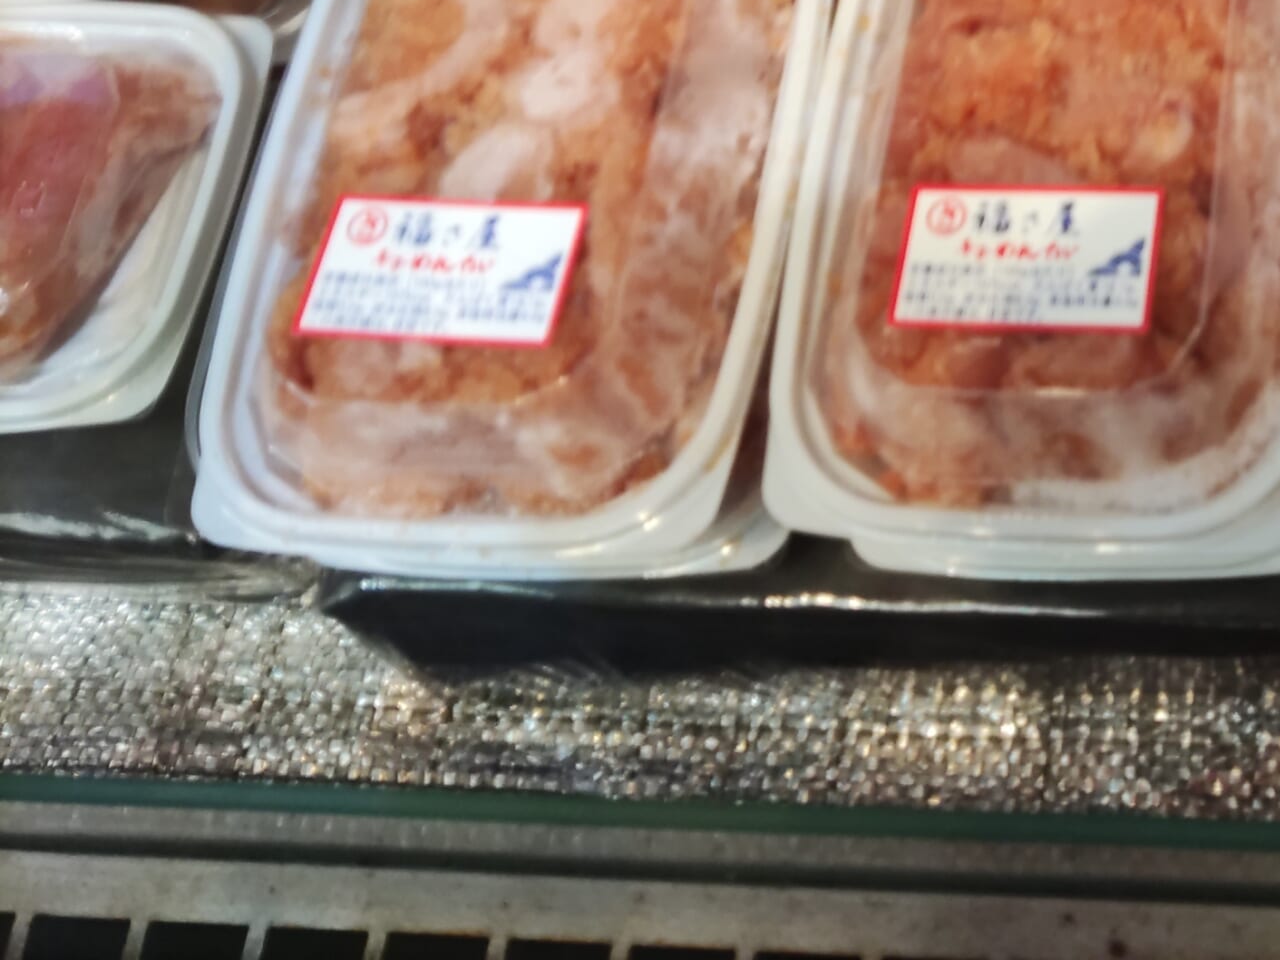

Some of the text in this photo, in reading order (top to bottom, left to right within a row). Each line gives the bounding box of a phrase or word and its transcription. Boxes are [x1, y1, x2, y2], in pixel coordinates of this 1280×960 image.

[394, 210, 501, 250] 福さ屋
[976, 199, 1079, 236] 福さ屋
